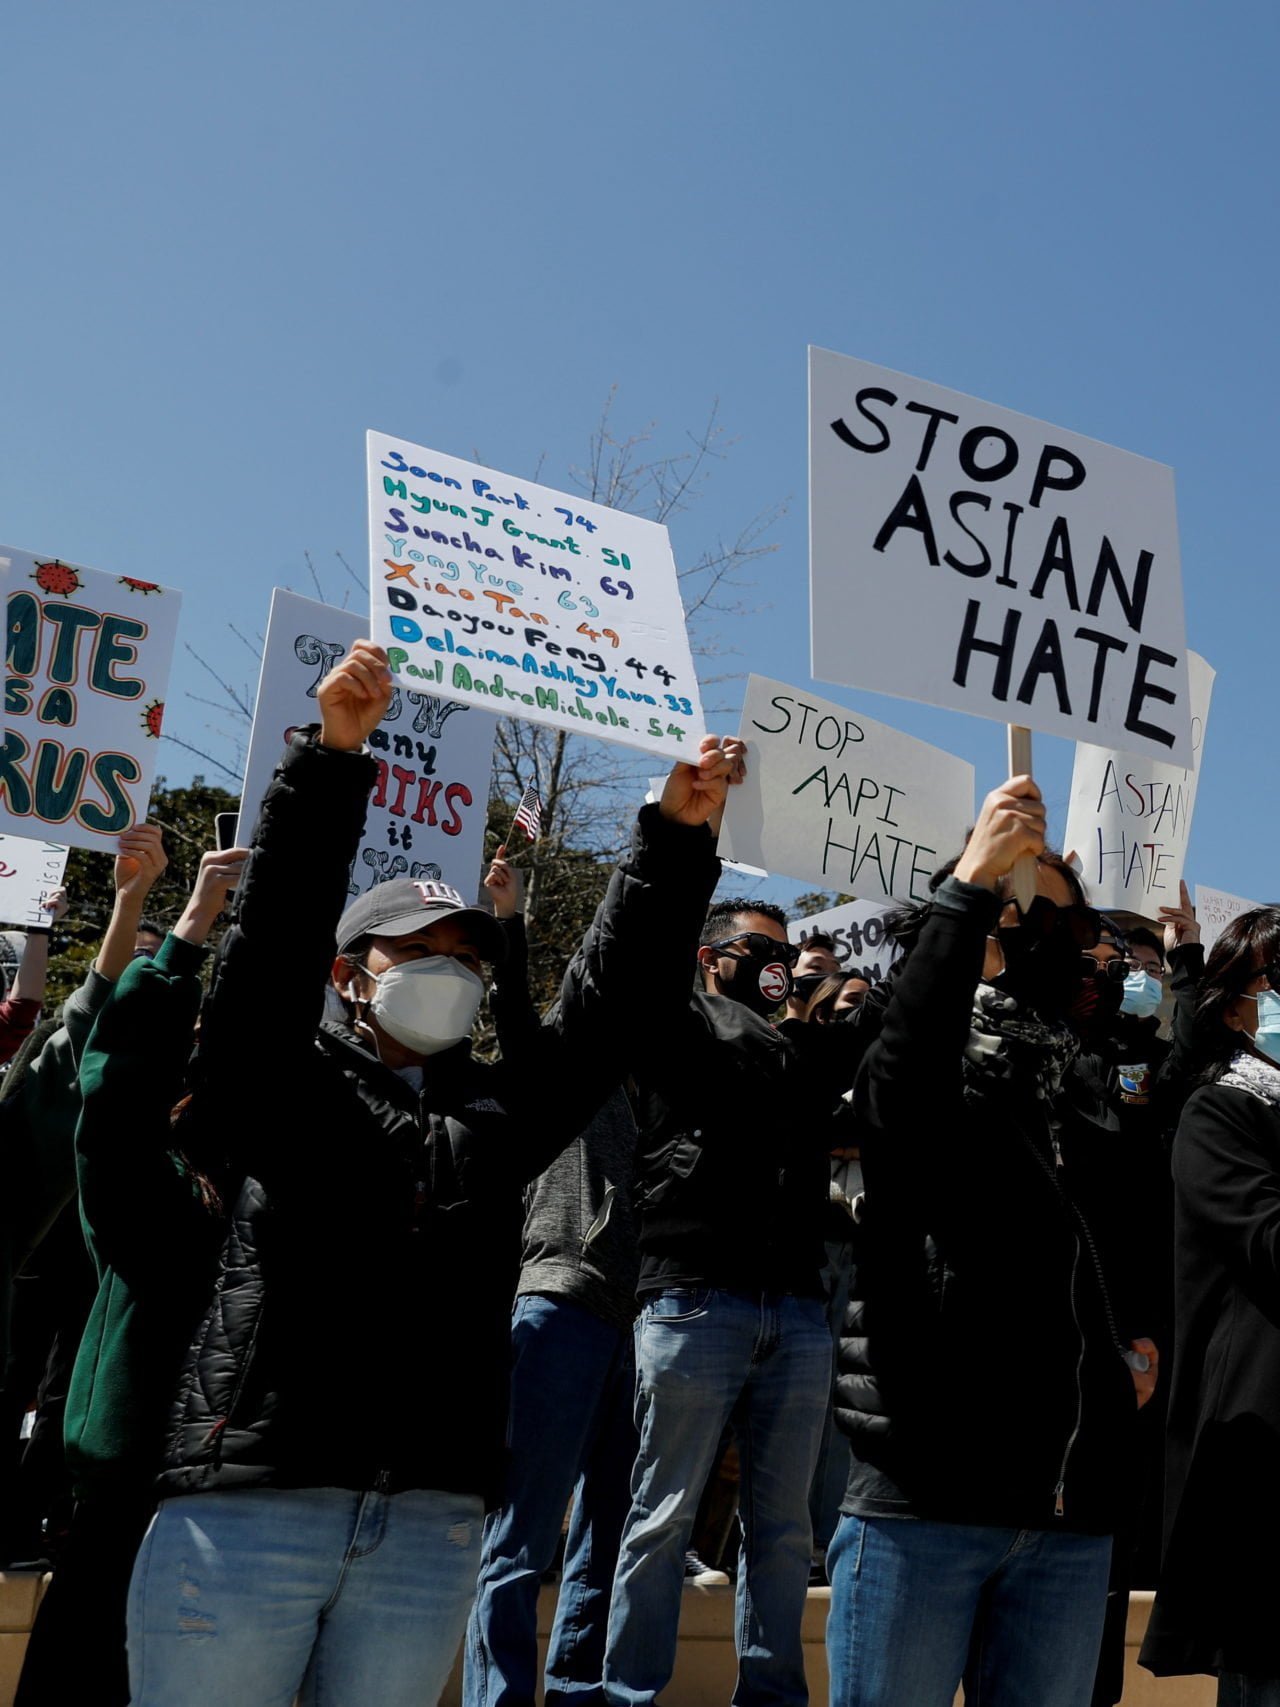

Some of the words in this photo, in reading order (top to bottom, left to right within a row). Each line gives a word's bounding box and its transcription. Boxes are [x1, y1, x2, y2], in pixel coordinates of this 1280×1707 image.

[830, 387, 1087, 508] STOP
[381, 451, 462, 490] Soon
[554, 507, 598, 533] 74
[383, 476, 467, 519] Hyun
[601, 548, 631, 570] 51
[385, 534, 460, 581] Yong
[557, 590, 599, 618] 63
[600, 576, 634, 600] 69
[872, 473, 1155, 633] ASIAN
[384, 558, 475, 601] Xiao
[576, 622, 620, 648] 49
[387, 586, 514, 635] Daoyou
[625, 657, 678, 686] 44
[37, 686, 77, 727] A
[386, 647, 444, 684] Paul
[647, 717, 686, 742] 54
[664, 694, 694, 715] 33
[952, 598, 1178, 750] HATE
[364, 728, 436, 776] any
[752, 696, 865, 759] STOP
[792, 766, 906, 827] AAPI
[1097, 759, 1190, 840] ASIAN
[822, 818, 937, 903] HATE
[1098, 827, 1175, 895] HATE
